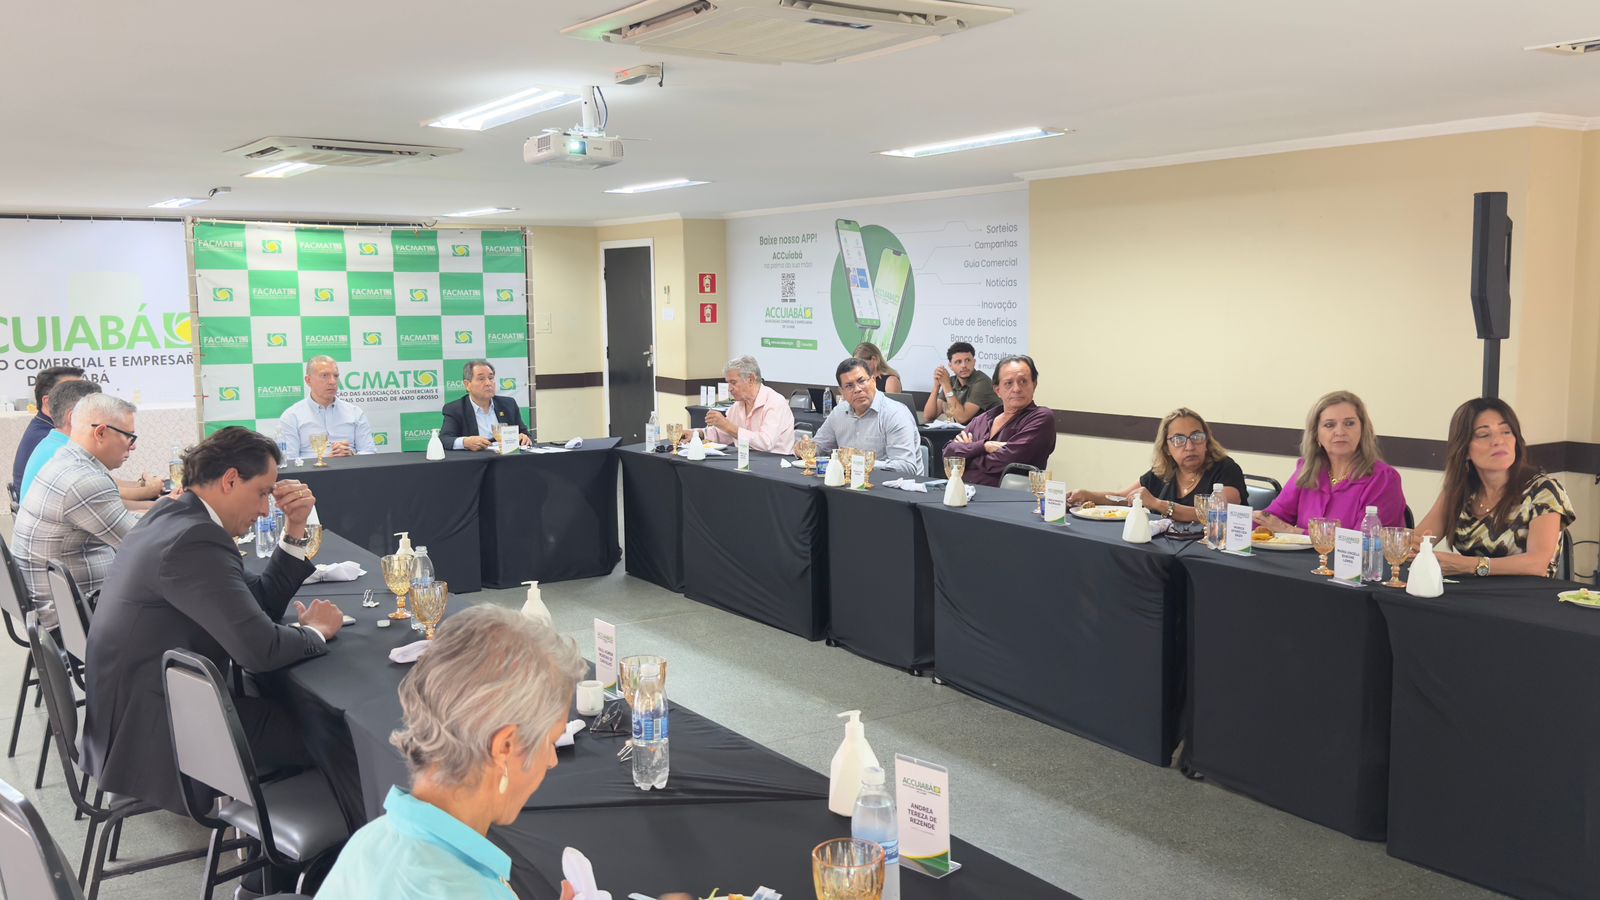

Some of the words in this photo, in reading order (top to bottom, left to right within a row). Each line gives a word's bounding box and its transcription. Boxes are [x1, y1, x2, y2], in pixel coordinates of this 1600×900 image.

[986, 223, 1018, 235] Sorteios
[198, 240, 234, 248] FACMAT
[759, 235, 778, 246] Baixe
[779, 235, 800, 244] nosso
[801, 233, 818, 244] APP!
[300, 241, 333, 249] FACMAT
[485, 245, 514, 253] FACMAT
[974, 239, 1018, 251] Campanhas
[963, 259, 980, 268] Guia
[980, 257, 1018, 268] Comercial
[985, 276, 1018, 288] Notícias
[252, 287, 290, 296] FACMAT
[351, 288, 384, 296] FACMAT
[442, 288, 471, 297] FACMAT
[981, 300, 1018, 312] Inovação
[942, 317, 965, 326] Clube
[965, 317, 976, 326] de
[977, 316, 1018, 327] Benefícios
[203, 335, 240, 345] FACMAT
[305, 334, 341, 343] FACMAT
[400, 334, 431, 342] FACMAT
[487, 333, 516, 341] FACMAT
[950, 333, 973, 343] Banco
[973, 333, 984, 344] de
[985, 334, 1018, 345] Talentos
[109, 356, 118, 367] E
[257, 385, 293, 394] FACMAT
[362, 388, 401, 397] ASSOCIAÇÕES
[910, 803, 933, 814] ANDREA
[907, 808, 929, 821] TEREZA
[929, 815, 937, 823] DE
[909, 817, 936, 830] REZENDE
